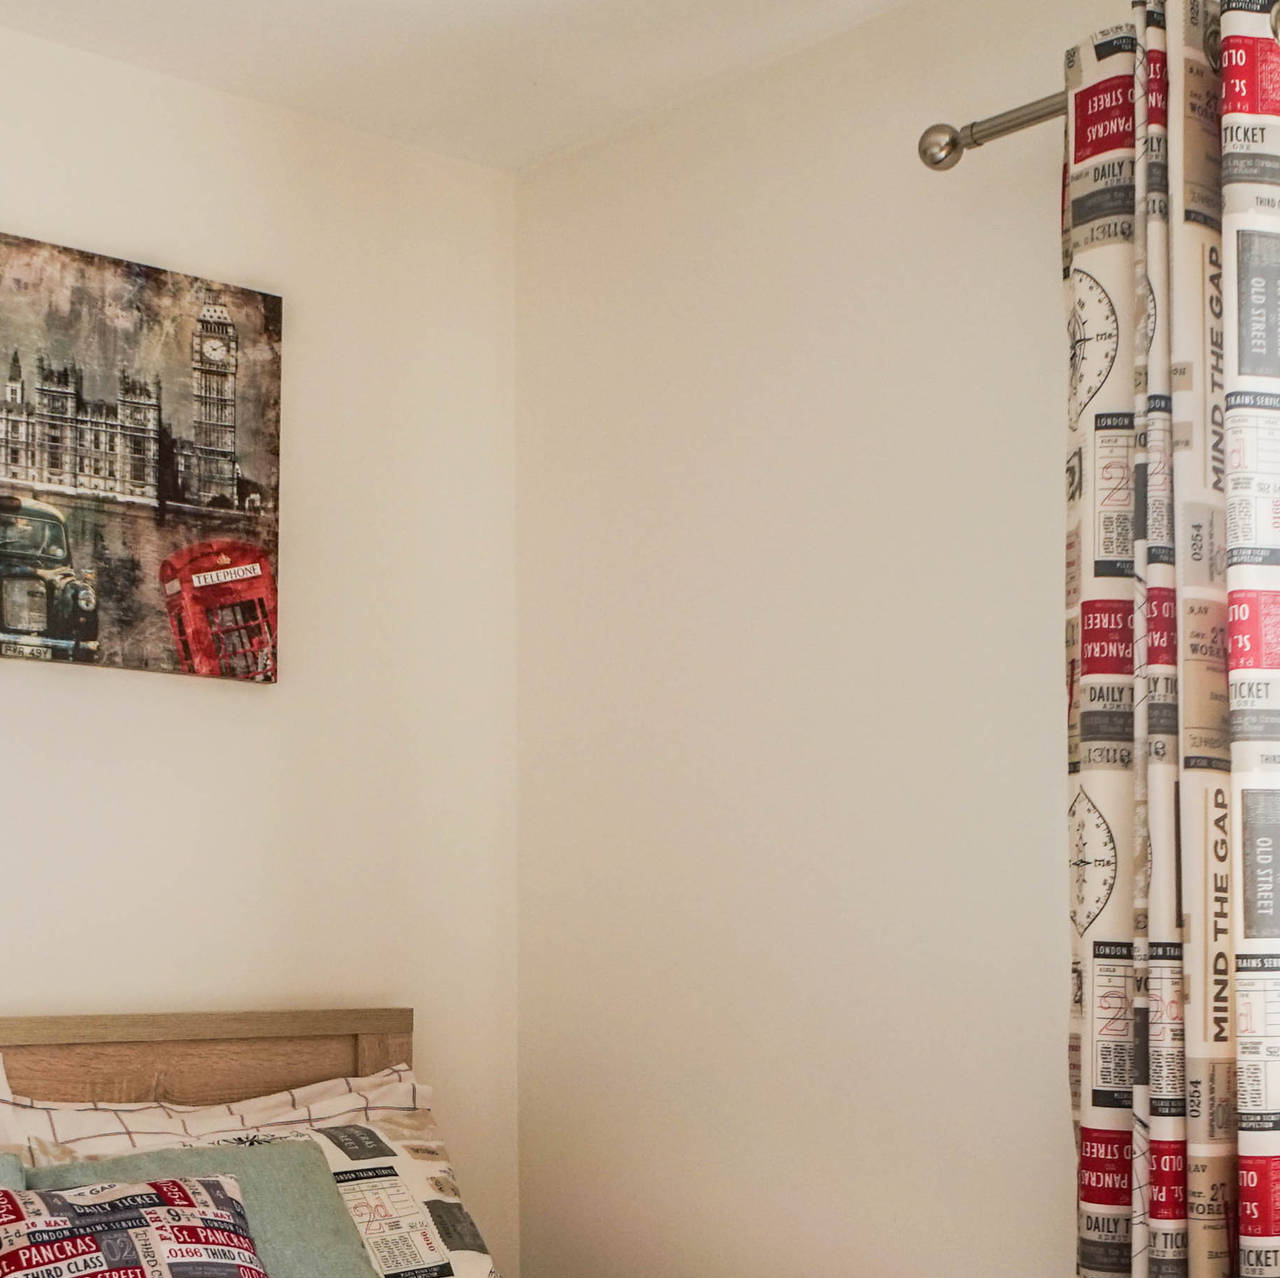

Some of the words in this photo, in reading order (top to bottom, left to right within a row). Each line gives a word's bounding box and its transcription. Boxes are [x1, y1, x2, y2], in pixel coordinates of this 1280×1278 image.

[1093, 162, 1125, 185] DAILY
[195, 564, 261, 586] TELEPHONE
[1090, 684, 1124, 702] DAILY
[1213, 788, 1230, 865] GAP
[1213, 872, 1230, 942] THE
[1213, 951, 1230, 1043] MIND
[73, 1204, 111, 1216] DAILY
[117, 1193, 160, 1207] TICKET
[29, 1230, 71, 1243] LONDON
[75, 1223, 108, 1235] TRAINS
[112, 1219, 148, 1231] SERVICE
[144, 1210, 171, 1241] FARE
[174, 1227, 196, 1243] St.
[19, 1236, 96, 1266] PANCRAS
[204, 1247, 236, 1261] THIRD
[67, 1255, 104, 1274] CLASS
